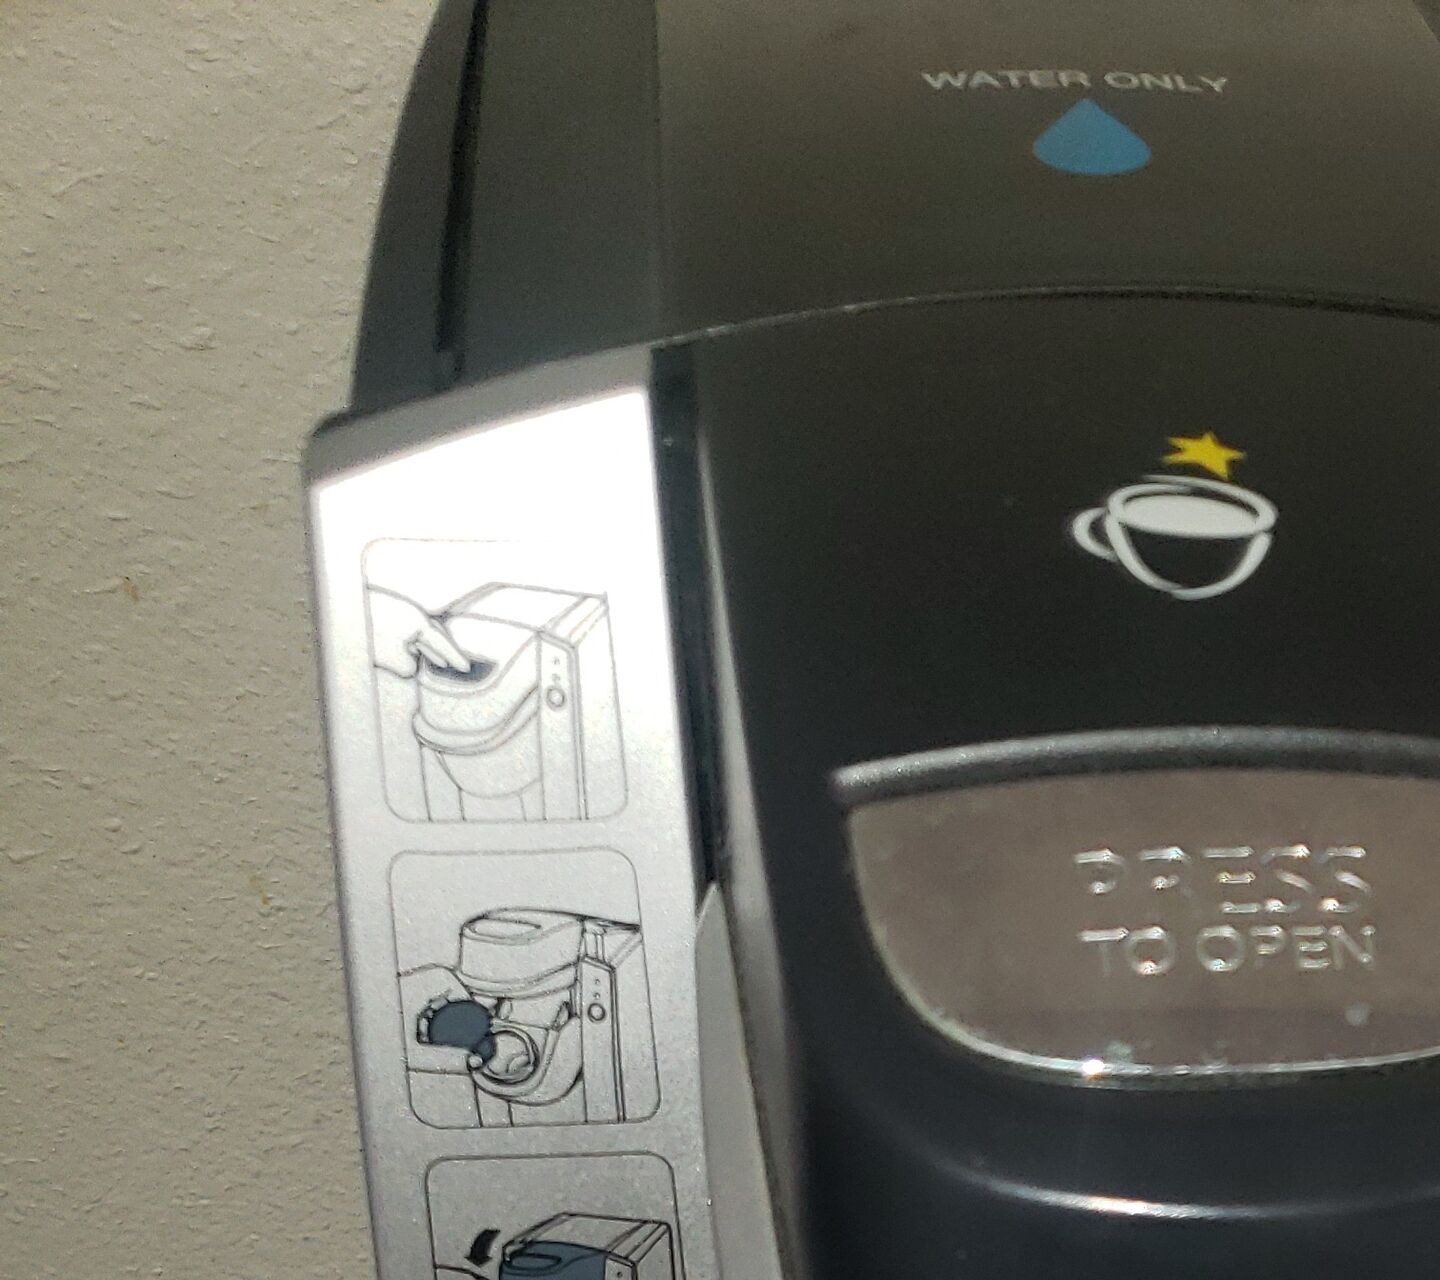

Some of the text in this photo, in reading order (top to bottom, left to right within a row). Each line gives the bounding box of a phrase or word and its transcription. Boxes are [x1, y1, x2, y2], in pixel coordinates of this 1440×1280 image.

[922, 69, 1229, 94] WATER ONLY
[1074, 844, 1372, 916] PRESS
[1078, 924, 1377, 978] TO OPEN
